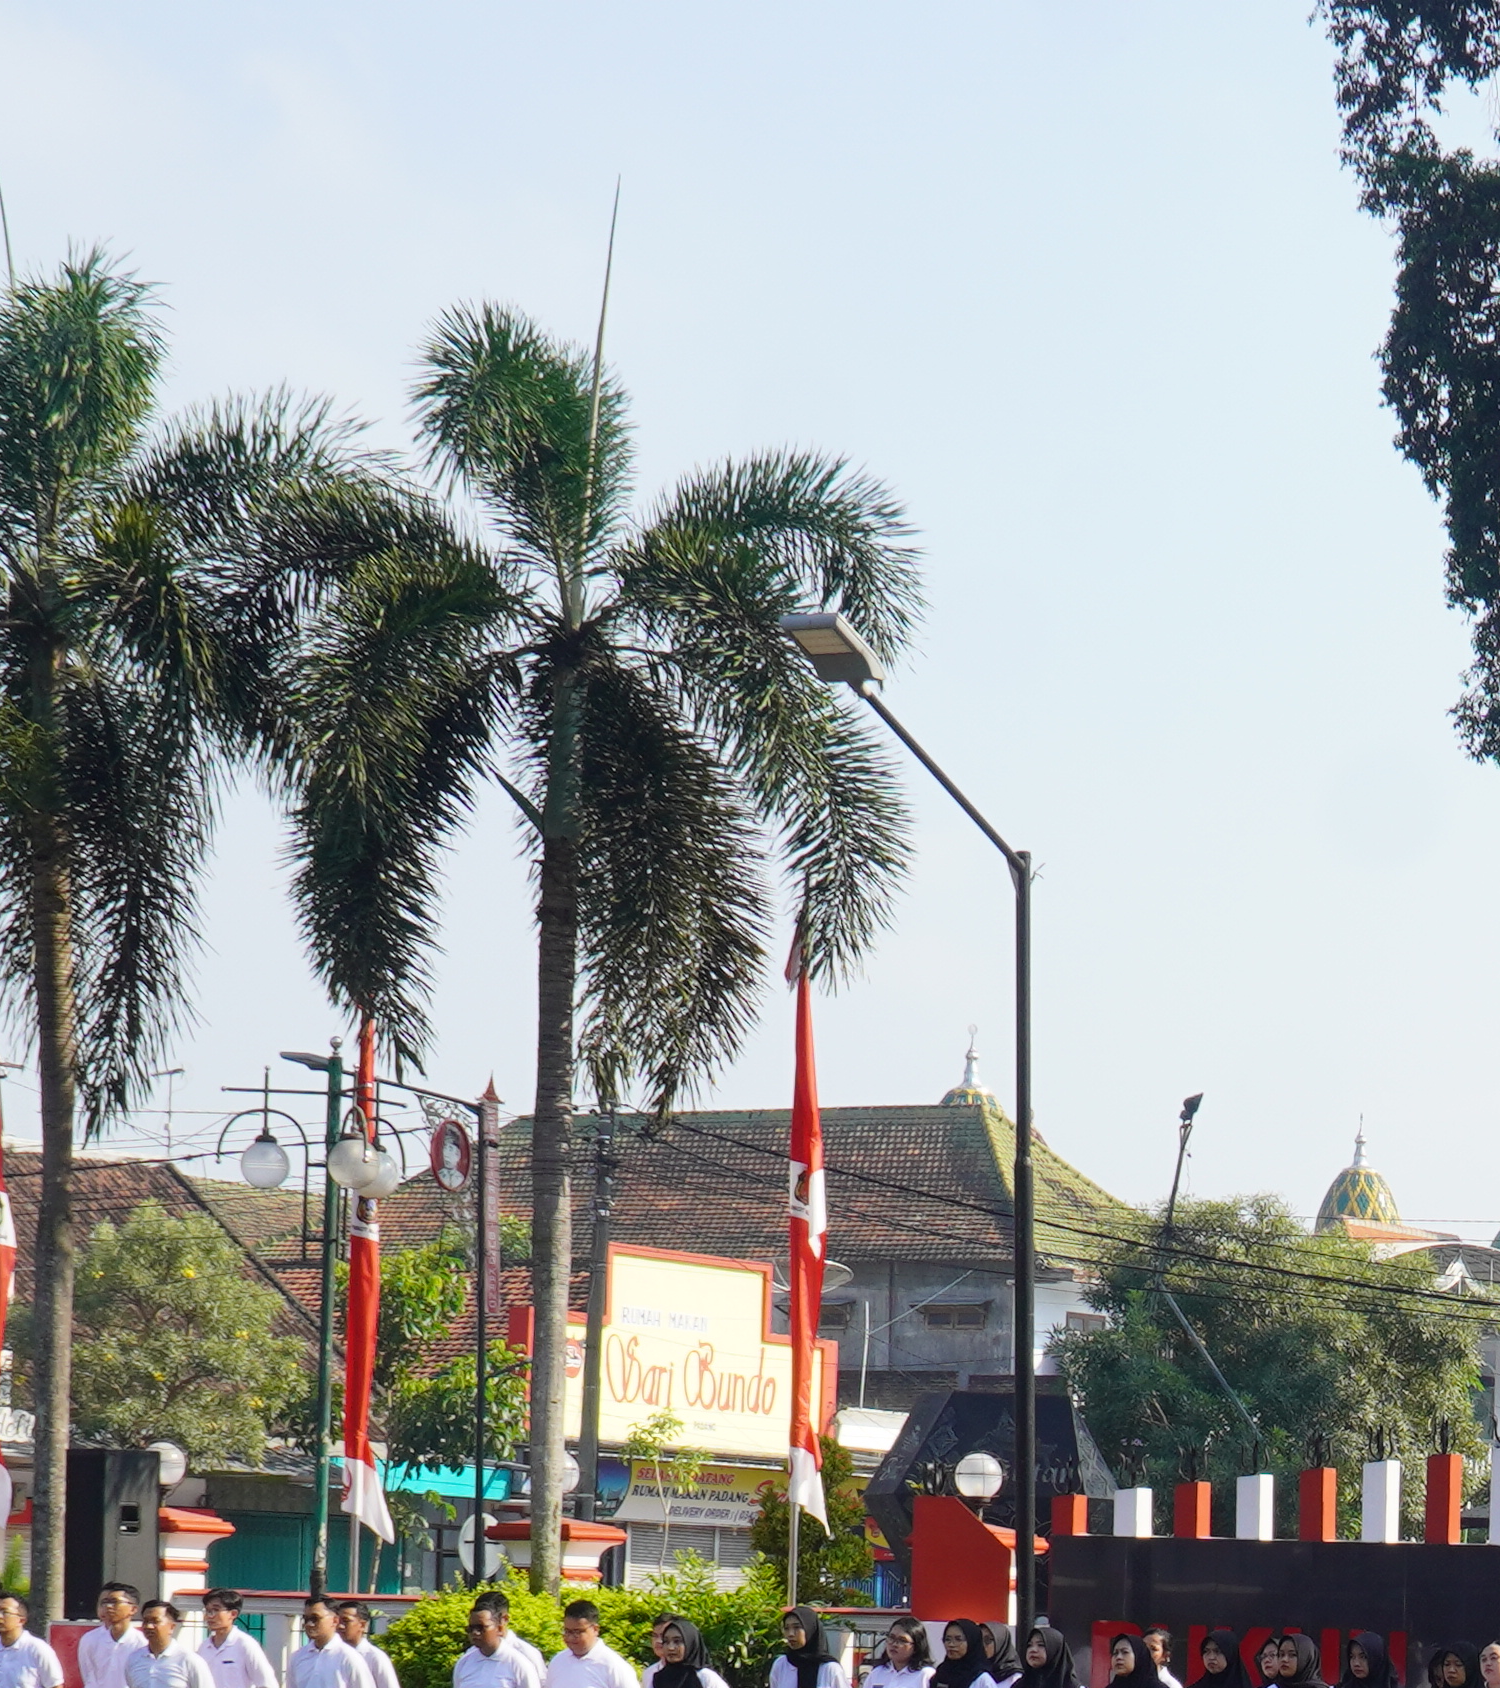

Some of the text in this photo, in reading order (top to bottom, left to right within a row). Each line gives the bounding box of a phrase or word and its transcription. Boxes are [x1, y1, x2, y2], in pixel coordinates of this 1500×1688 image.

[621, 1306, 709, 1332] RUMAH MAKAN
[606, 1333, 776, 1416] Sari Bundo
[708, 1489, 749, 1503] PADANG
[668, 1505, 704, 1518] DELIVERY
